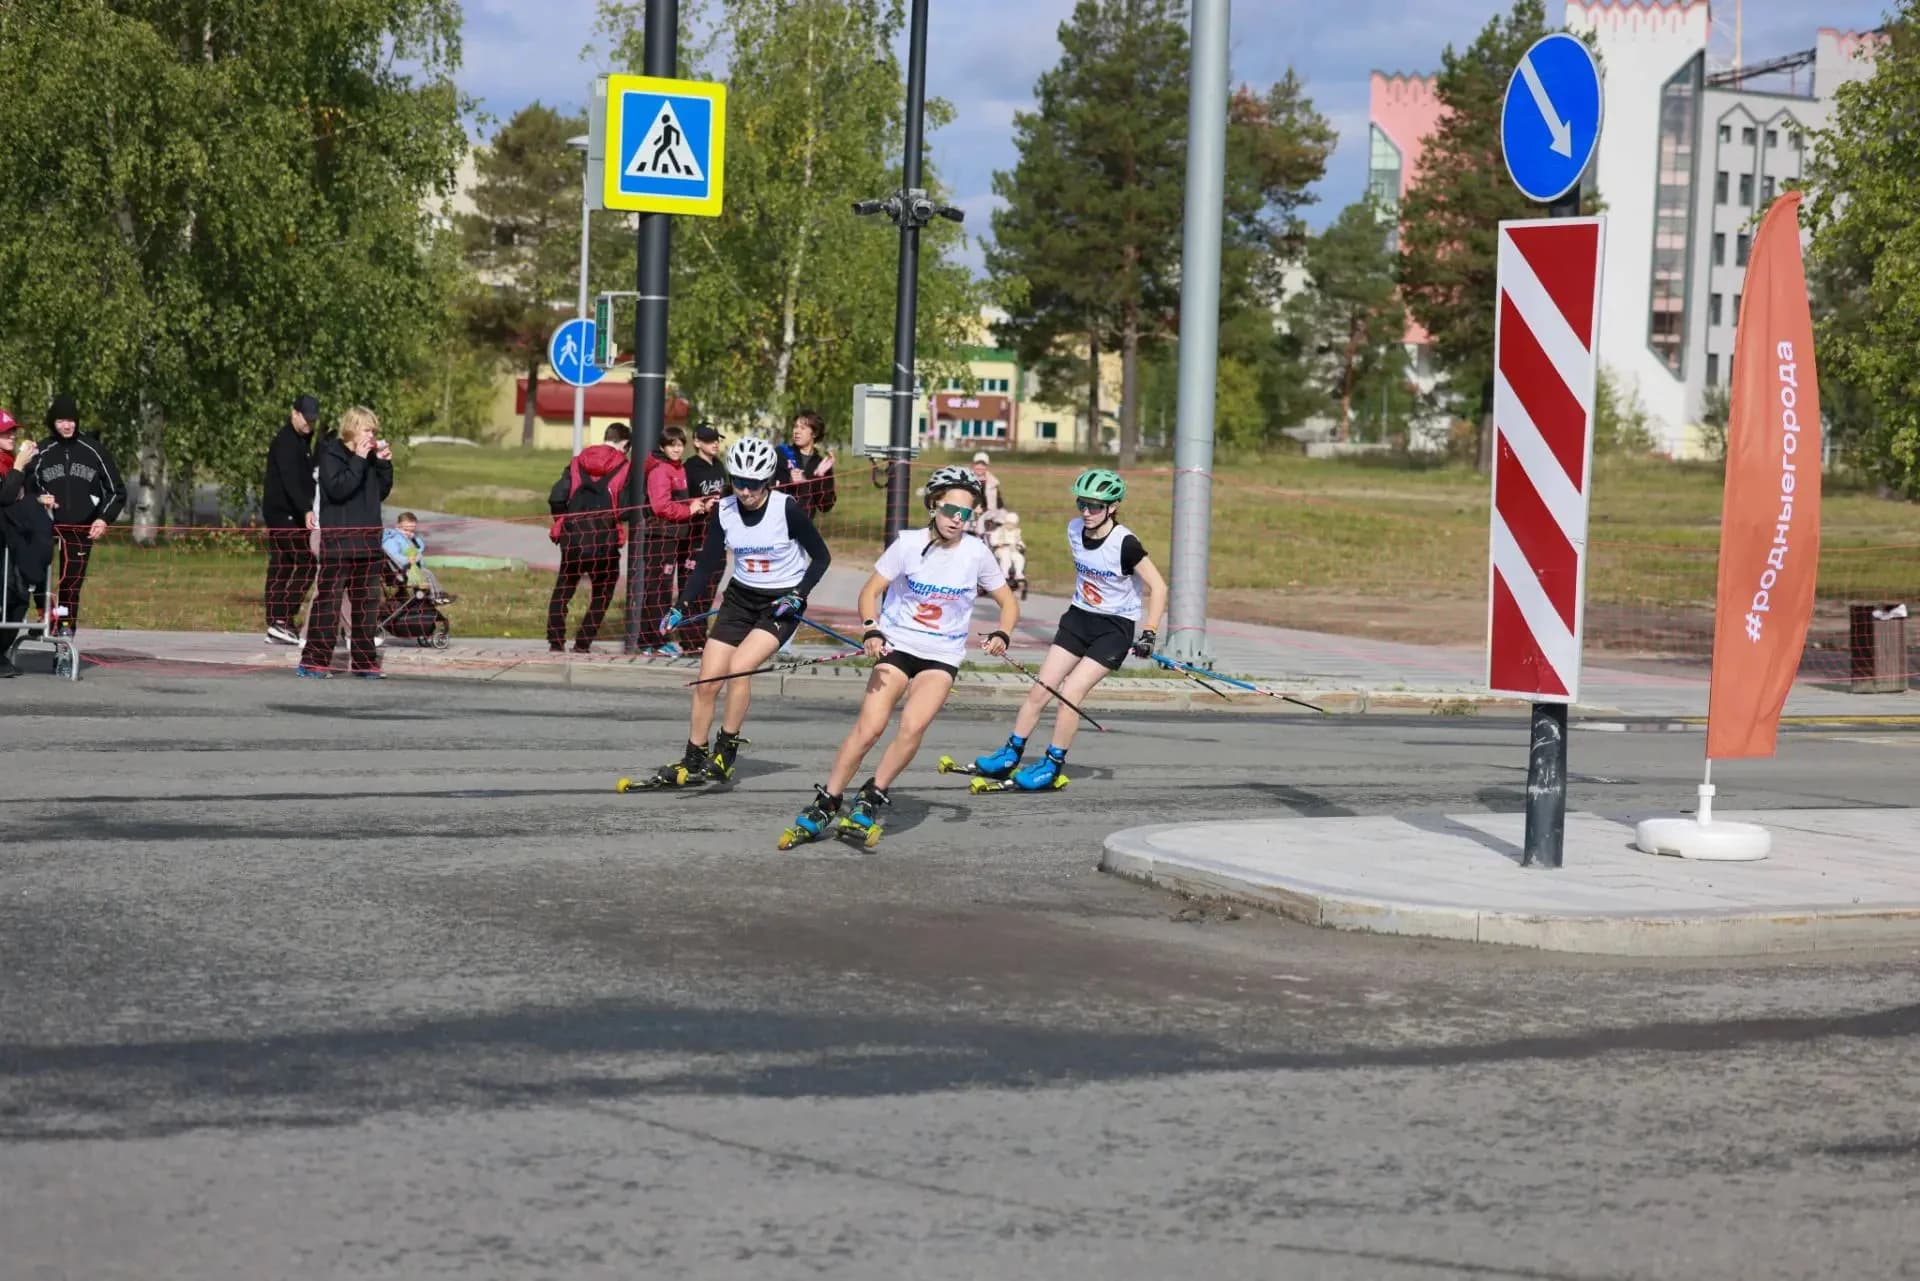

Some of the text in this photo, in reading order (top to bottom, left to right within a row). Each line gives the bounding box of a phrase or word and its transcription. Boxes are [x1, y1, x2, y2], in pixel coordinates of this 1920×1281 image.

[1745, 341, 1801, 644] #родныегорода
[743, 558, 770, 573] 11
[912, 602, 943, 630] 2
